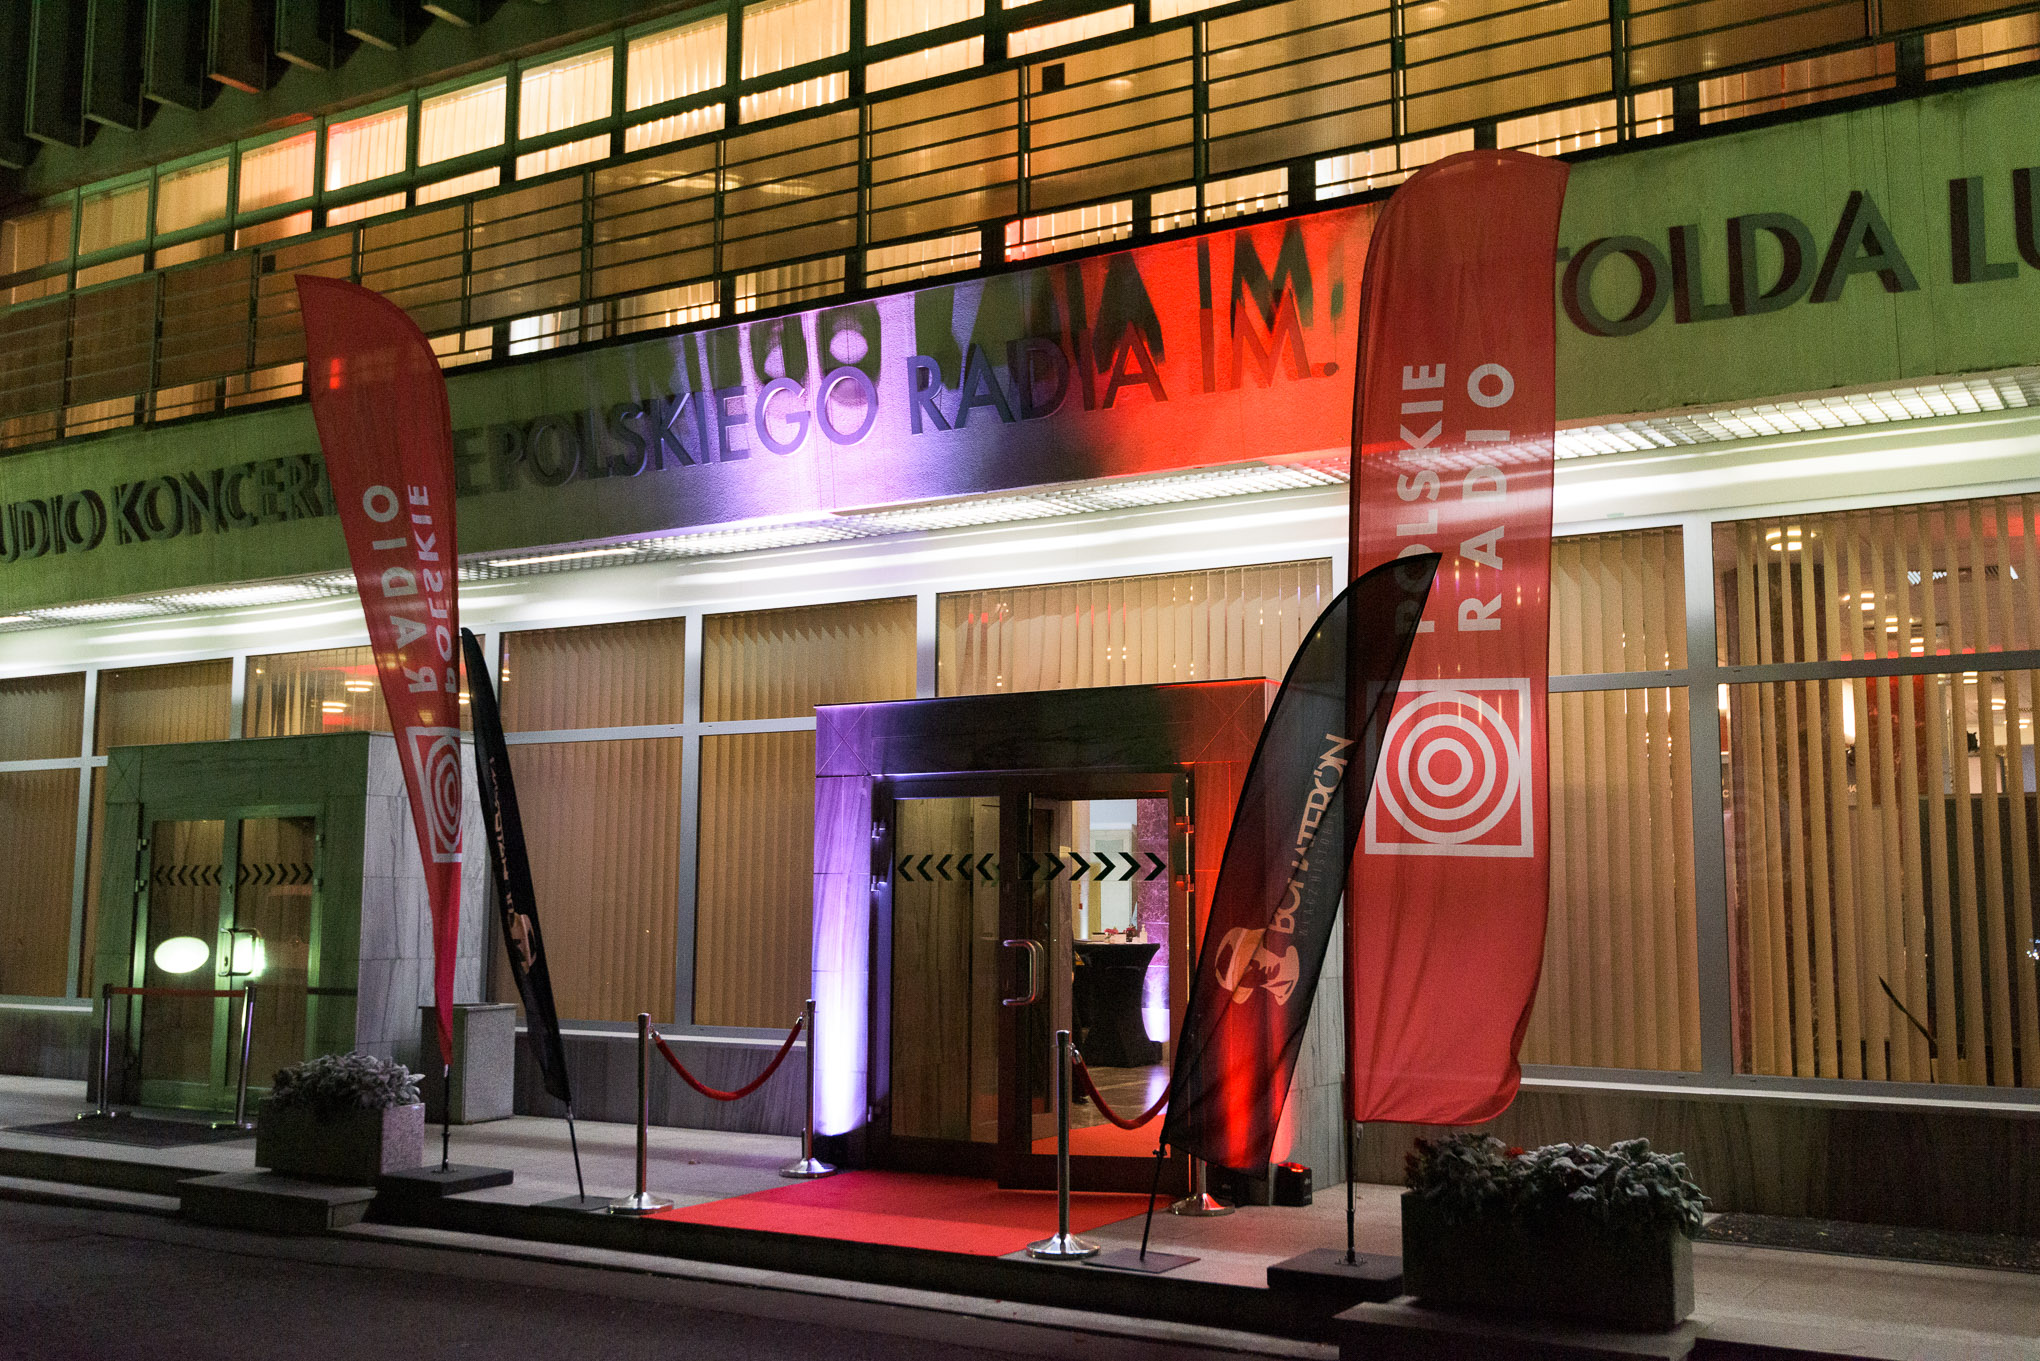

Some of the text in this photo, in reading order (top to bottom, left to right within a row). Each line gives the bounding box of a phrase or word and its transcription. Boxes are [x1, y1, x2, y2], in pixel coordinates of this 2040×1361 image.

[488, 366, 879, 494] POLSKIEGO
[906, 321, 1168, 435] RADIA
[1200, 287, 1339, 394] IM.
[1555, 189, 1921, 337] OLDA
[1458, 363, 1515, 632] RADIO
